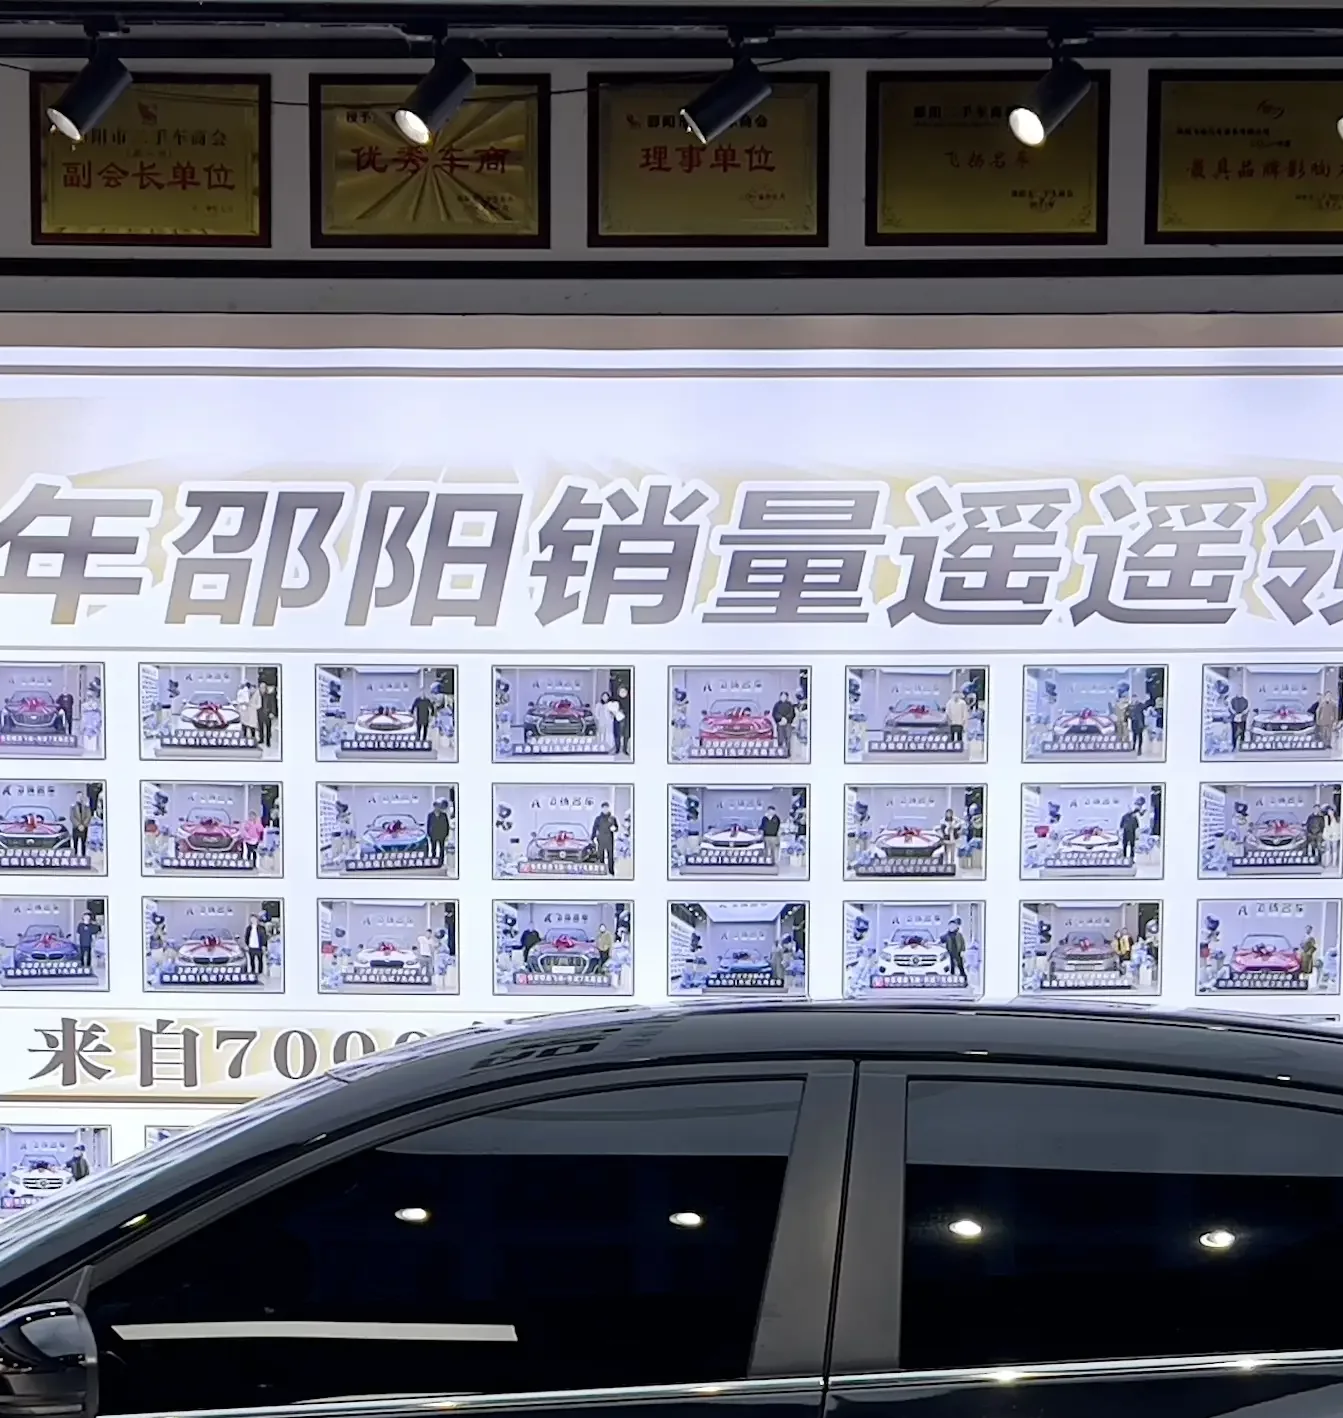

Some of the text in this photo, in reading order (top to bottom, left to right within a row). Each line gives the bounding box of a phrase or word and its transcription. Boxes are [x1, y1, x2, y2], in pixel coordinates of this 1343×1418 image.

[351, 146, 511, 173] 优秀车商
[640, 144, 776, 173] 理事单位
[61, 161, 235, 190] 副会长单位
